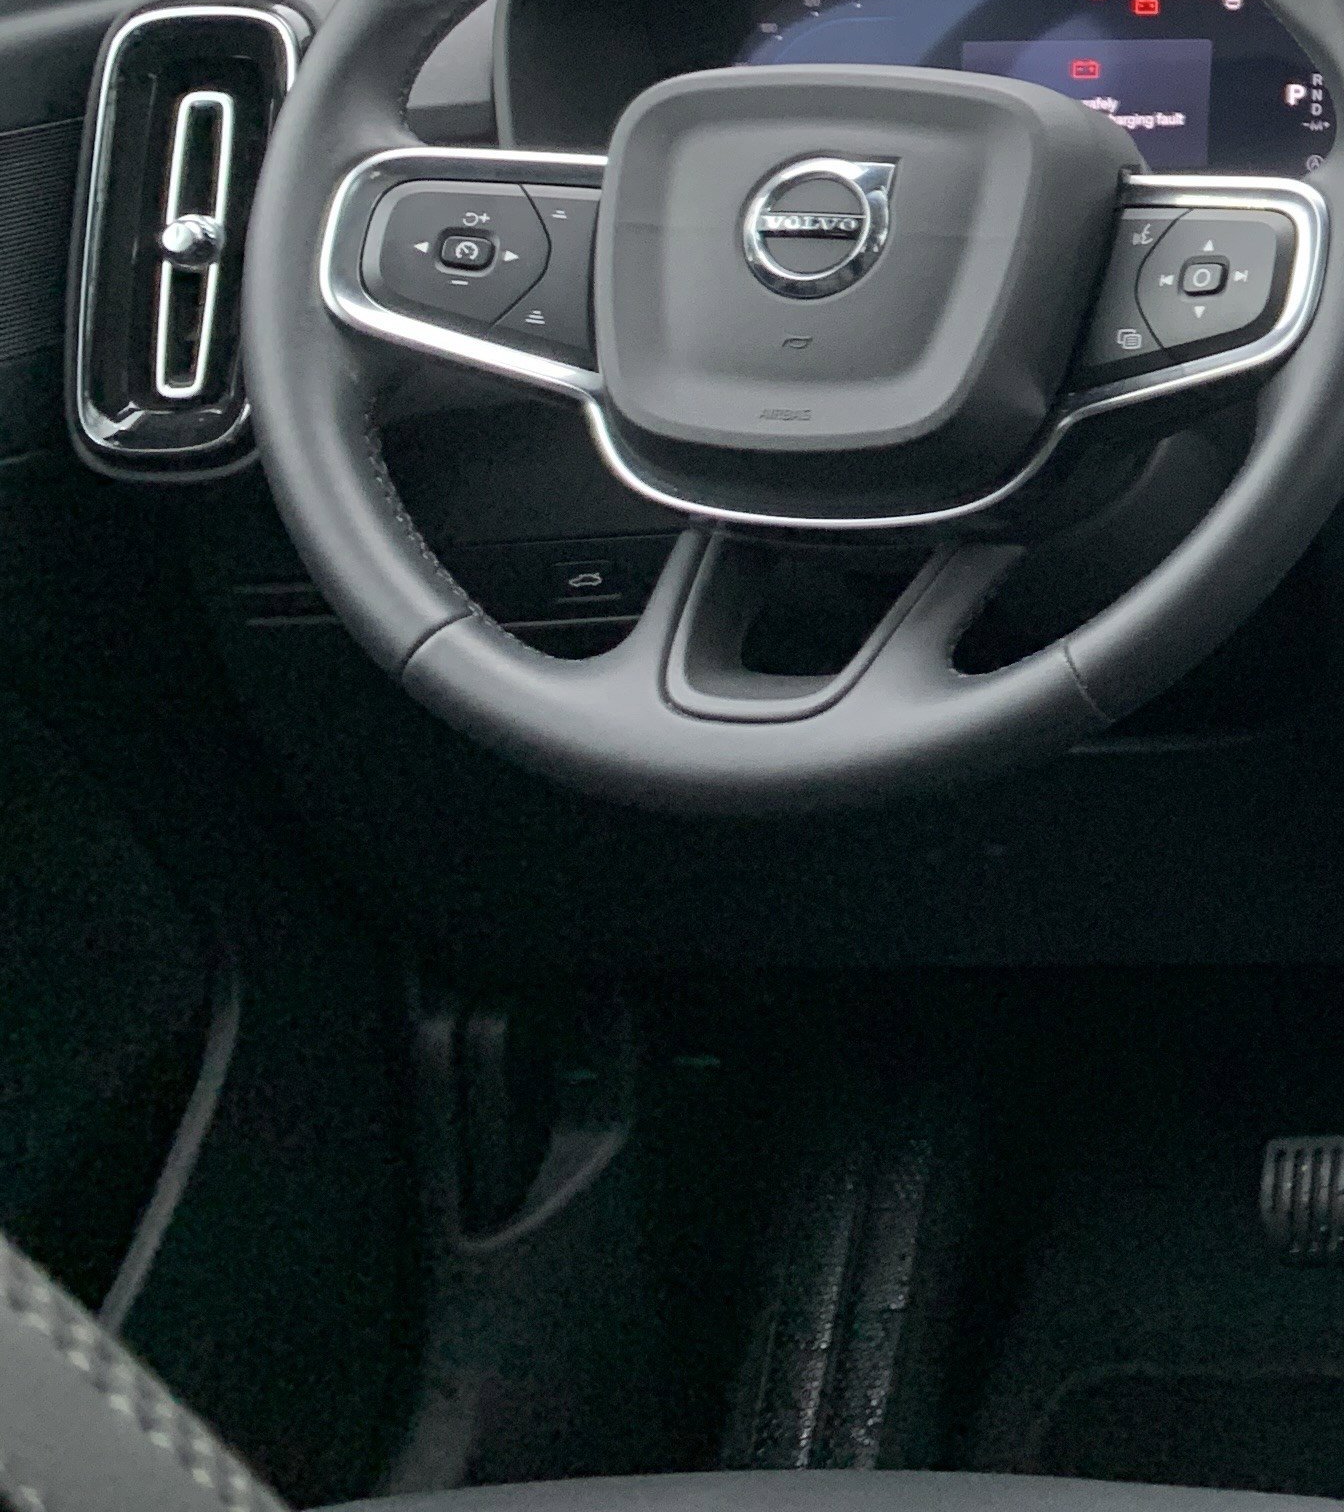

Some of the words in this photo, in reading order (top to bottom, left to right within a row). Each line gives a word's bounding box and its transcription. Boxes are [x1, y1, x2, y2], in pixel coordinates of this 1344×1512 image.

[1312, 73, 1323, 86] R
[1284, 83, 1306, 106] P
[1311, 89, 1323, 101] N
[1311, 102, 1323, 116] D
[1155, 112, 1186, 126] fault
[761, 215, 859, 231] VOLVO
[758, 409, 812, 421] AIRBAG
